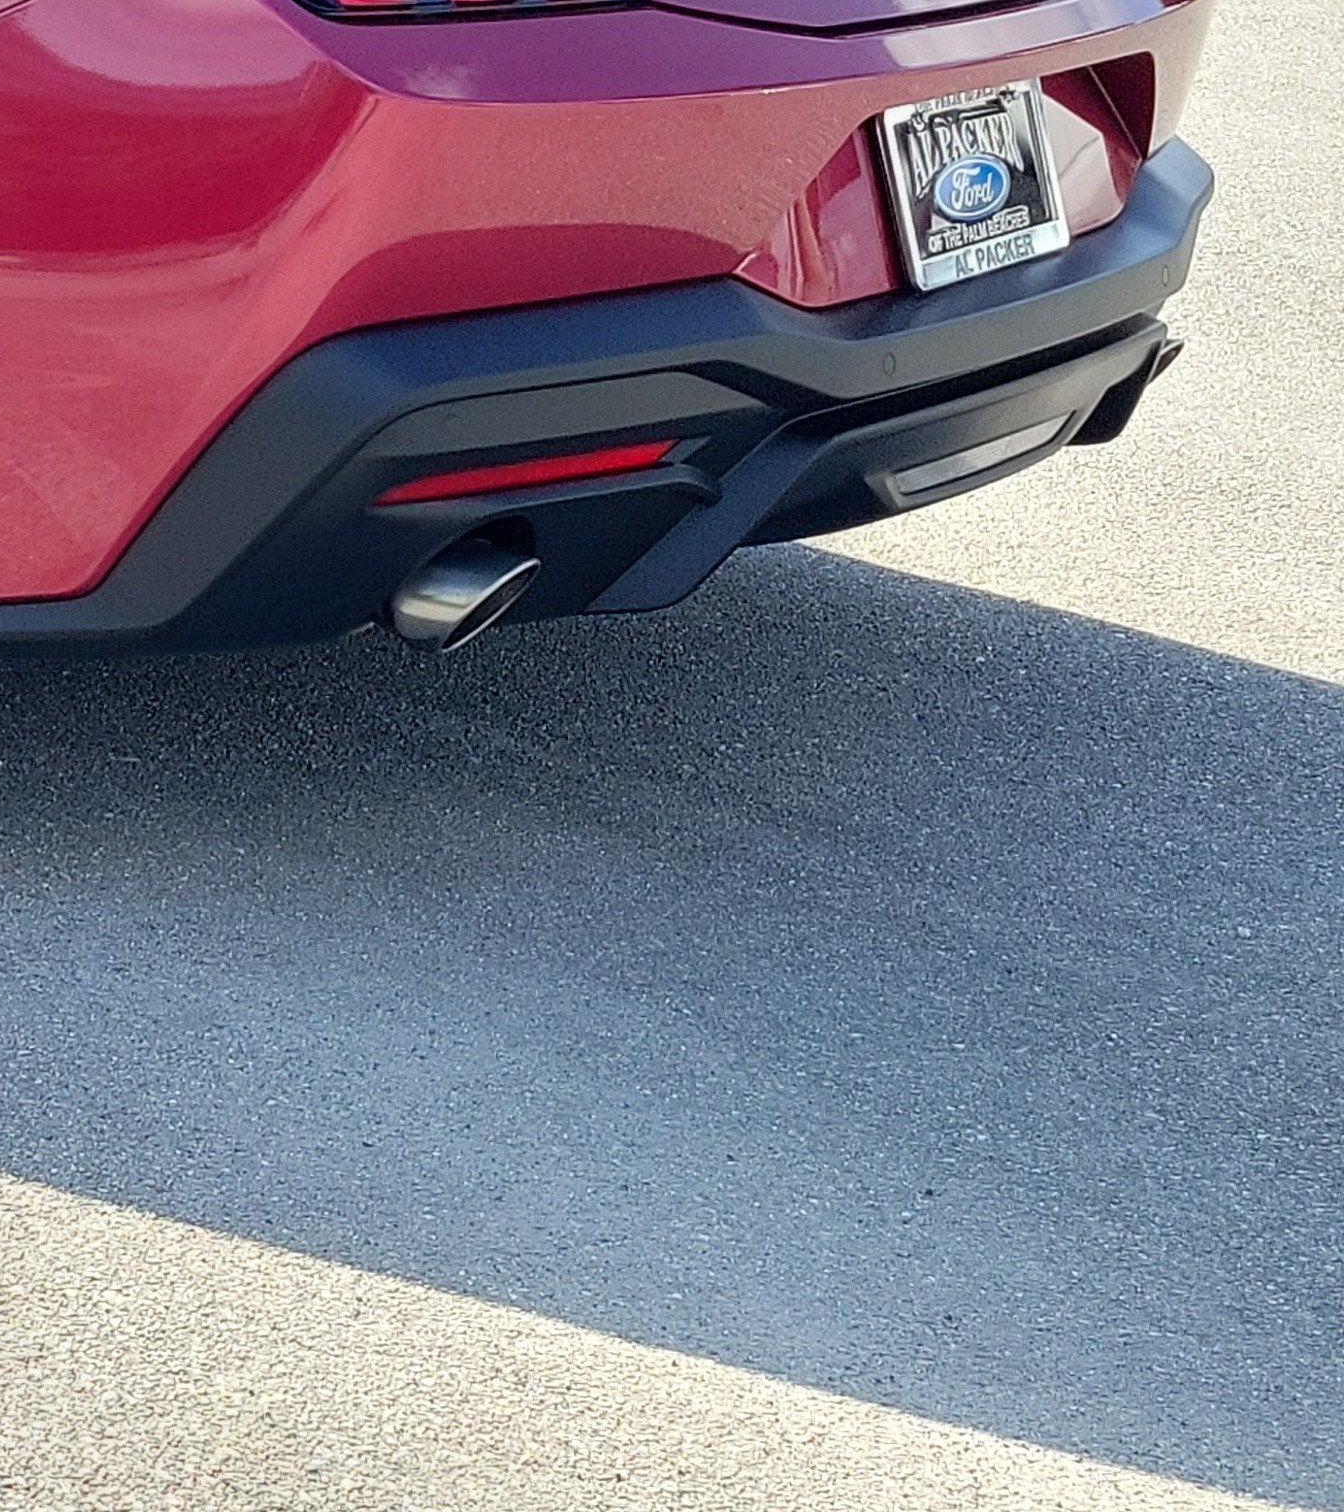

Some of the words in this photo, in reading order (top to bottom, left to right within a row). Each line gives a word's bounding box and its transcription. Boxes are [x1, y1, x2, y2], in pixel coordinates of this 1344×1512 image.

[908, 129, 942, 200] AL
[933, 114, 1024, 173] PACKER
[951, 167, 994, 210] Ford
[928, 234, 944, 253] OF
[942, 226, 963, 250] THE
[962, 221, 989, 245] PALM
[954, 250, 974, 279] AL
[975, 233, 1035, 271] PACKER
